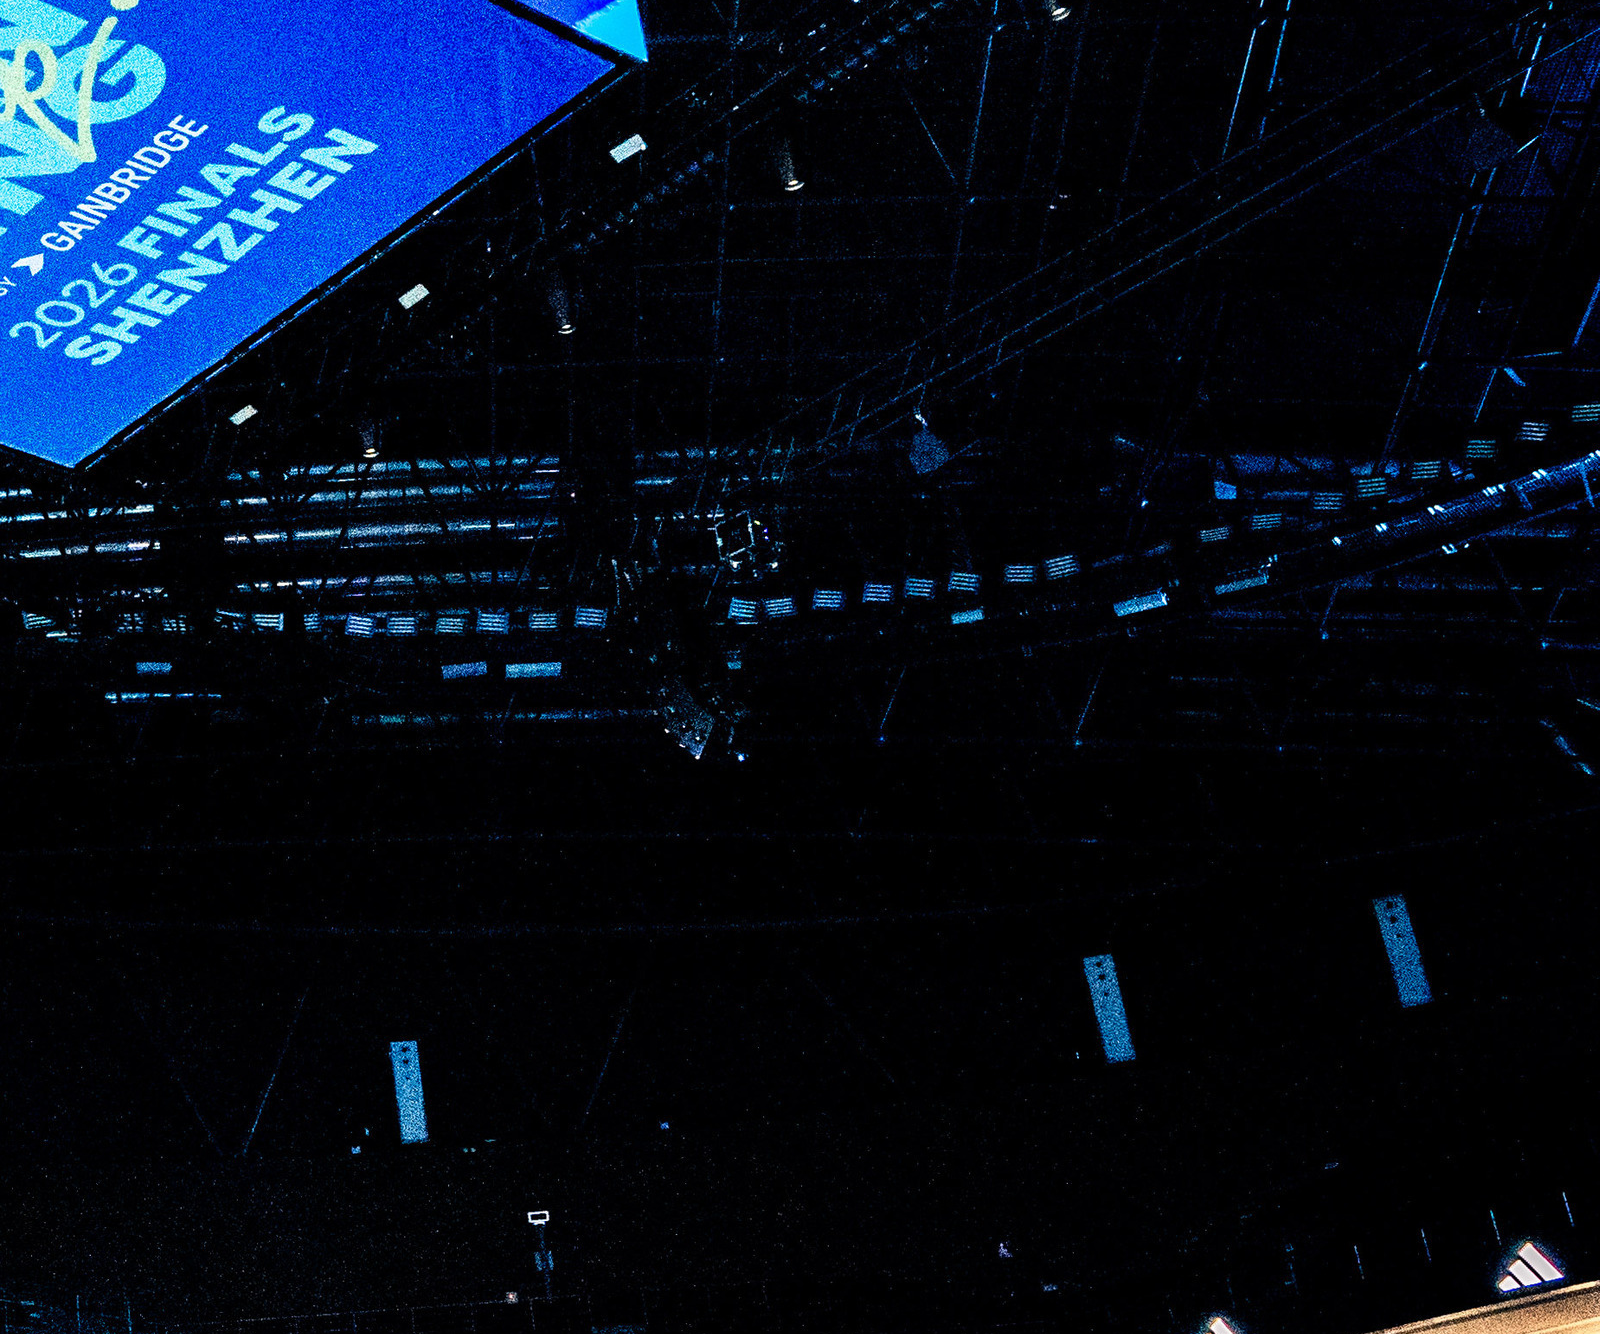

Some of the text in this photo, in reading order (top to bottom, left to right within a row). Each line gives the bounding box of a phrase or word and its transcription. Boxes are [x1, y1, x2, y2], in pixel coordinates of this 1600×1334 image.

[8, 106, 315, 350] 2026 FINALS
[40, 114, 208, 252] GAINBRIDGE
[65, 128, 379, 366] SHENZHEN
